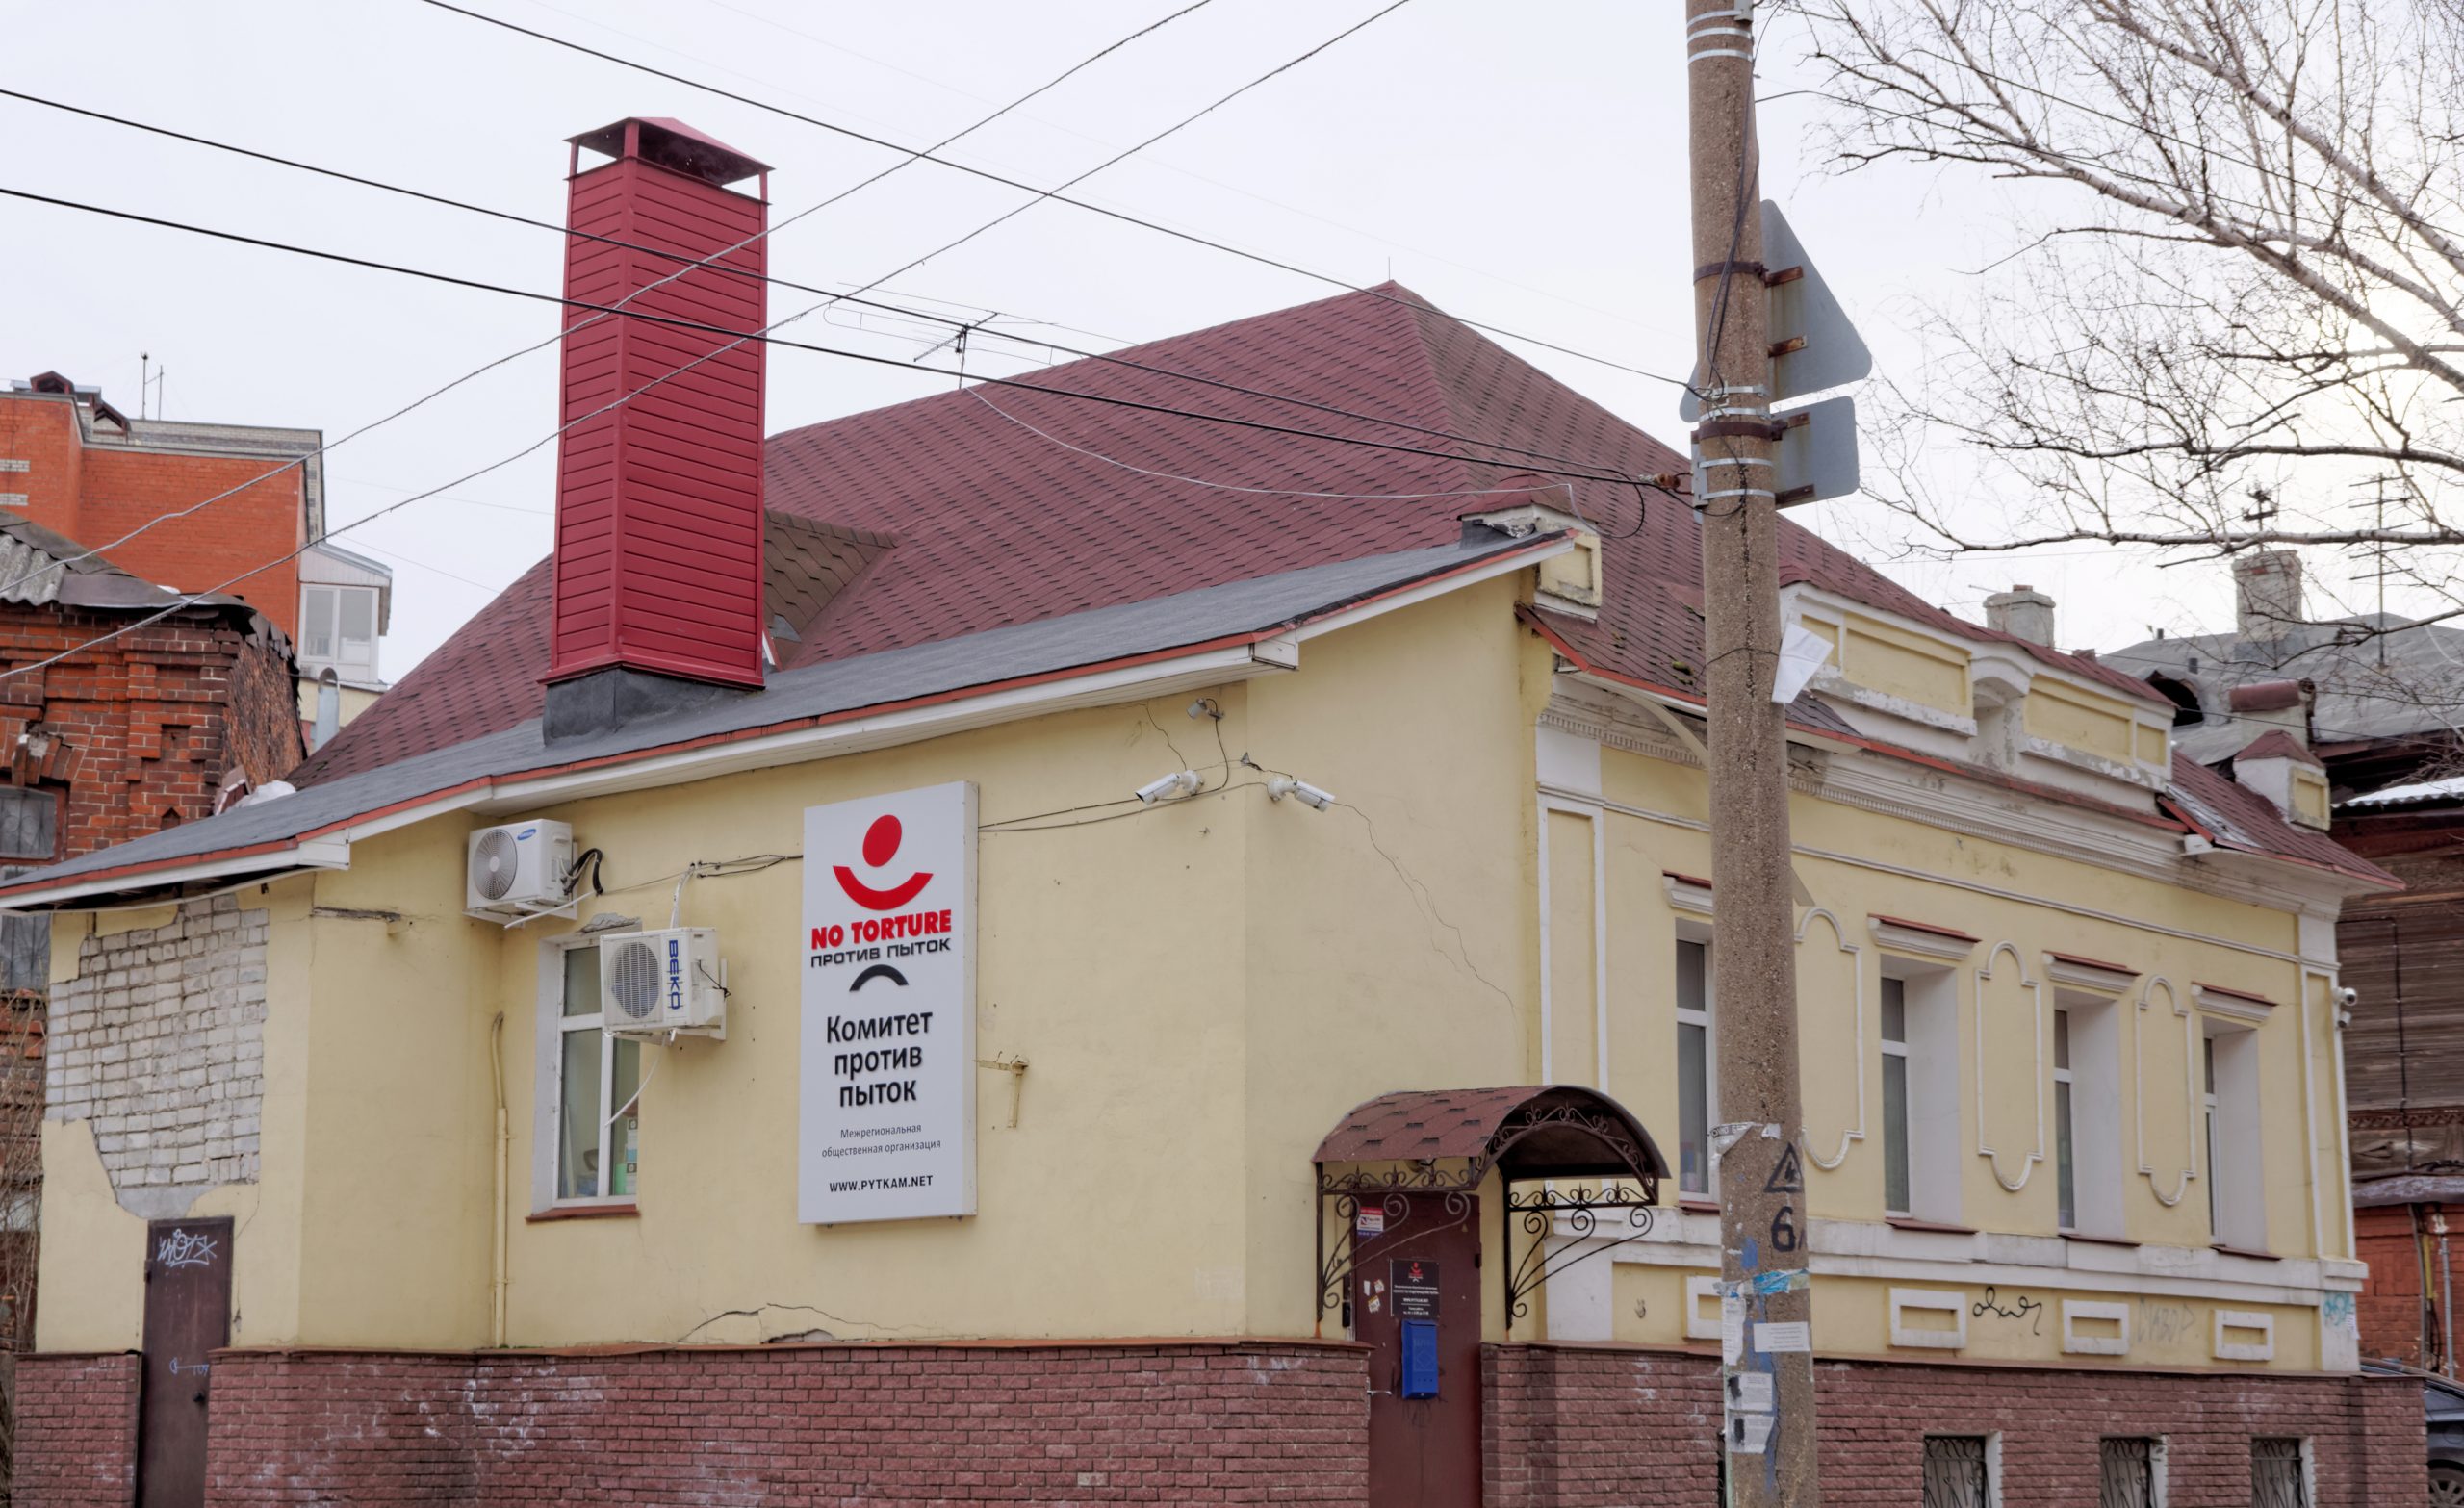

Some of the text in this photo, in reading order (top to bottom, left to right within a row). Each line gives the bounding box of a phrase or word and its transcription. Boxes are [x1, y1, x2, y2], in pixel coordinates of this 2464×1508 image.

[811, 908, 951, 950] NO TORTURE
[810, 937, 952, 968] ПРОТИВ ПЫТОК
[669, 939, 680, 1010] BEKO
[827, 1011, 933, 1043] Комитет
[834, 1046, 922, 1081] против
[840, 1080, 916, 1108] пыток
[840, 1124, 922, 1139] Межрегиональная
[821, 1139, 941, 1159] общественная организация
[829, 1174, 934, 1193] WWW.PYTKAM.NET
